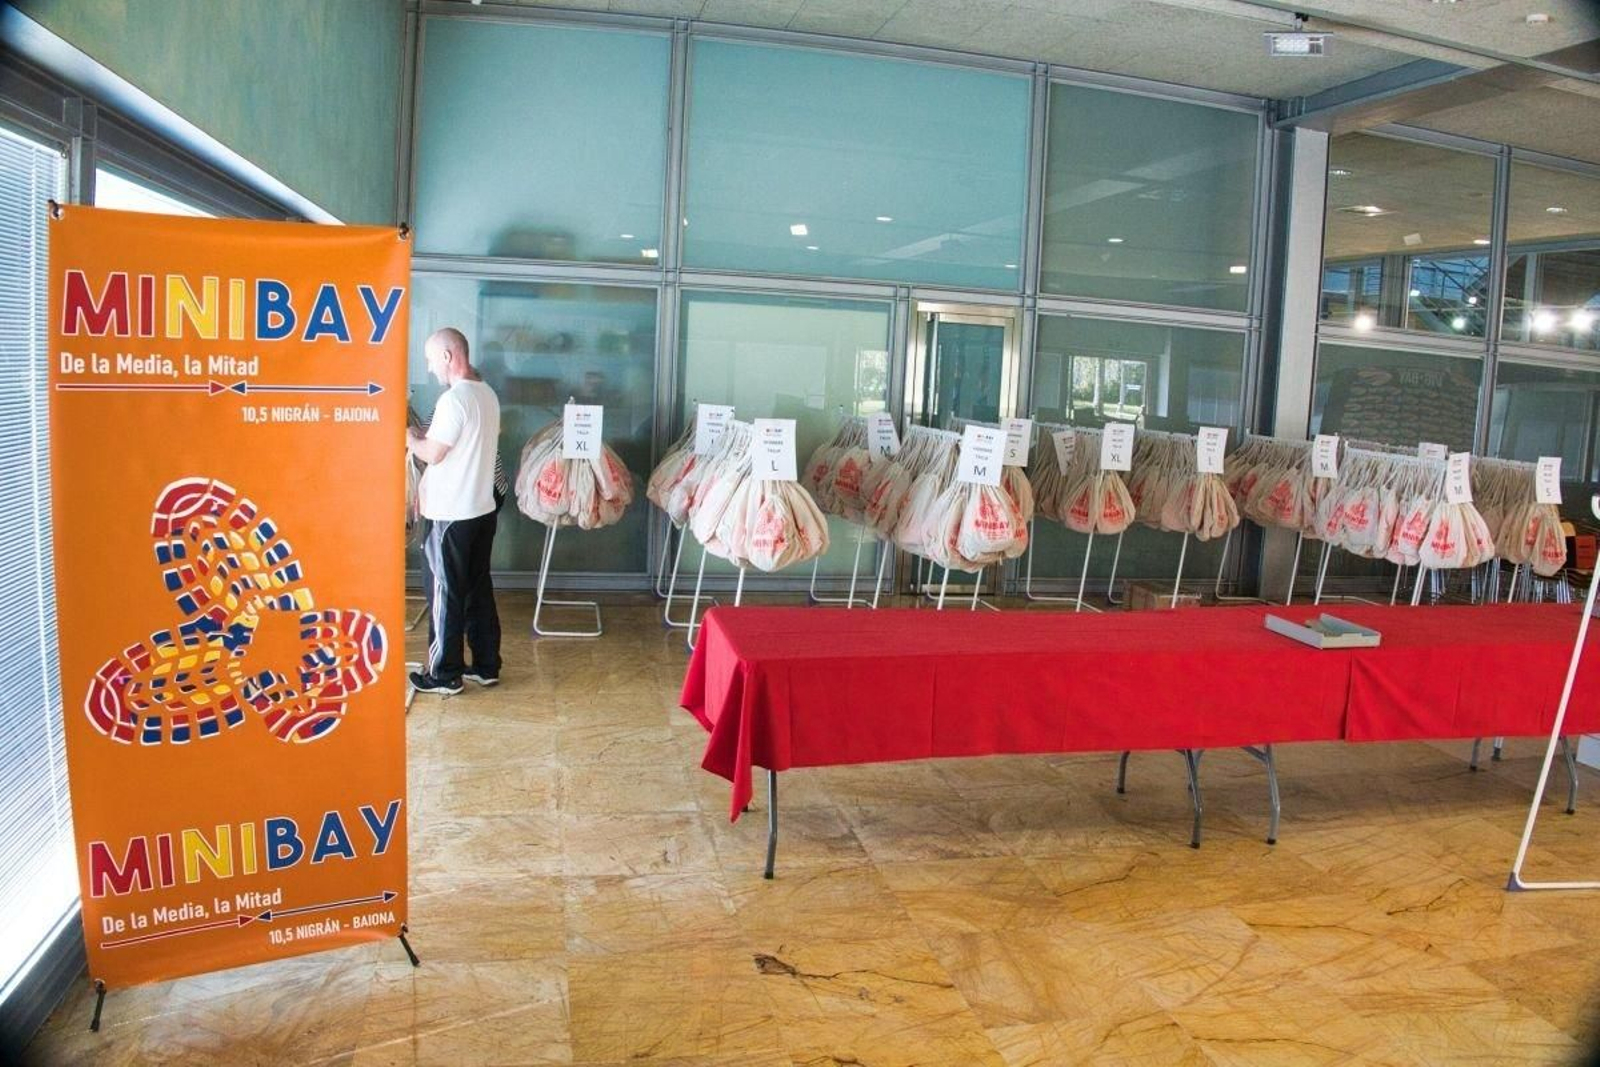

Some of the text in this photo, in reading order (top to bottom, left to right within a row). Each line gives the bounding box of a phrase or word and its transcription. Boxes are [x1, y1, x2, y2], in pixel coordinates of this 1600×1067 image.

[61, 269, 406, 345] MINIBAY
[60, 351, 260, 379] De la Media, la Mitad
[241, 406, 268, 425] 10,5
[271, 403, 321, 423] NIGRÁN
[333, 406, 381, 423] BAIONA
[575, 440, 589, 451] XL
[1010, 448, 1018, 458] S
[1110, 452, 1124, 464] XL
[771, 459, 780, 472] L
[1208, 455, 1216, 467] L
[1320, 461, 1329, 472] M
[973, 464, 987, 477] M
[88, 798, 402, 899] MINIBAY
[102, 887, 283, 935] De la Media, la Mitad
[268, 927, 294, 945] 10,5
[296, 917, 341, 940] NIGRÁN
[352, 911, 396, 930] BAIONA
